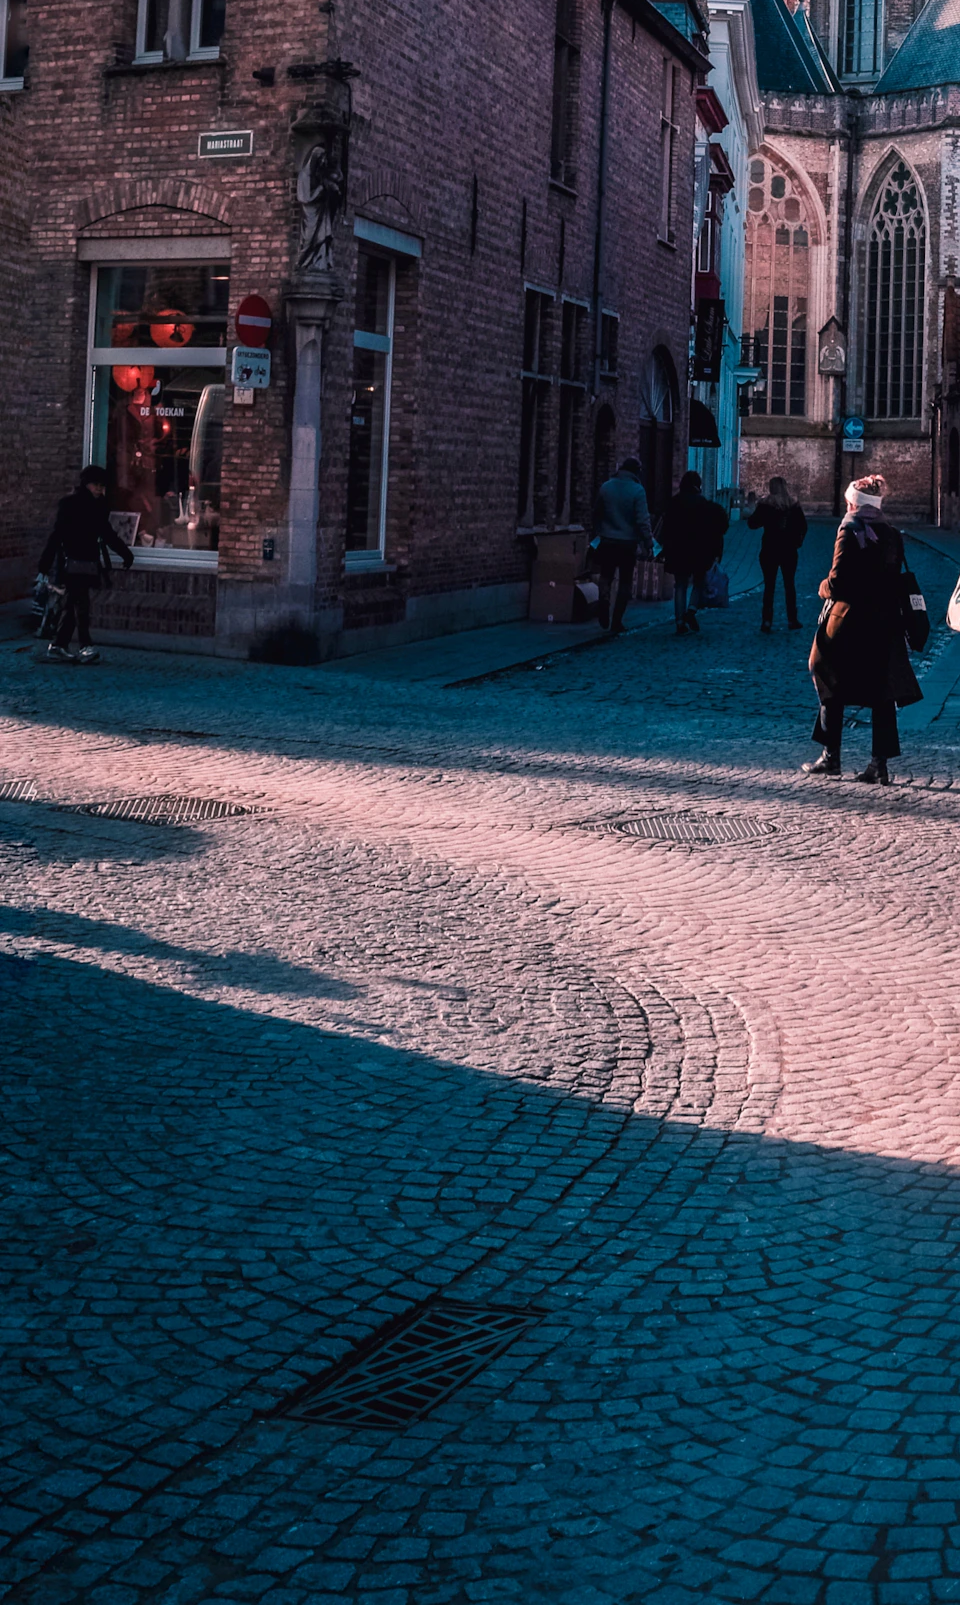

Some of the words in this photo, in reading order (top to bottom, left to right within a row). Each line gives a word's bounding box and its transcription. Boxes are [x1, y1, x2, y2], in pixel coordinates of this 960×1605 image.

[207, 138, 244, 150] MARIASTRAAT
[140, 407, 150, 416] DE
[155, 407, 185, 417] TOEKAN
